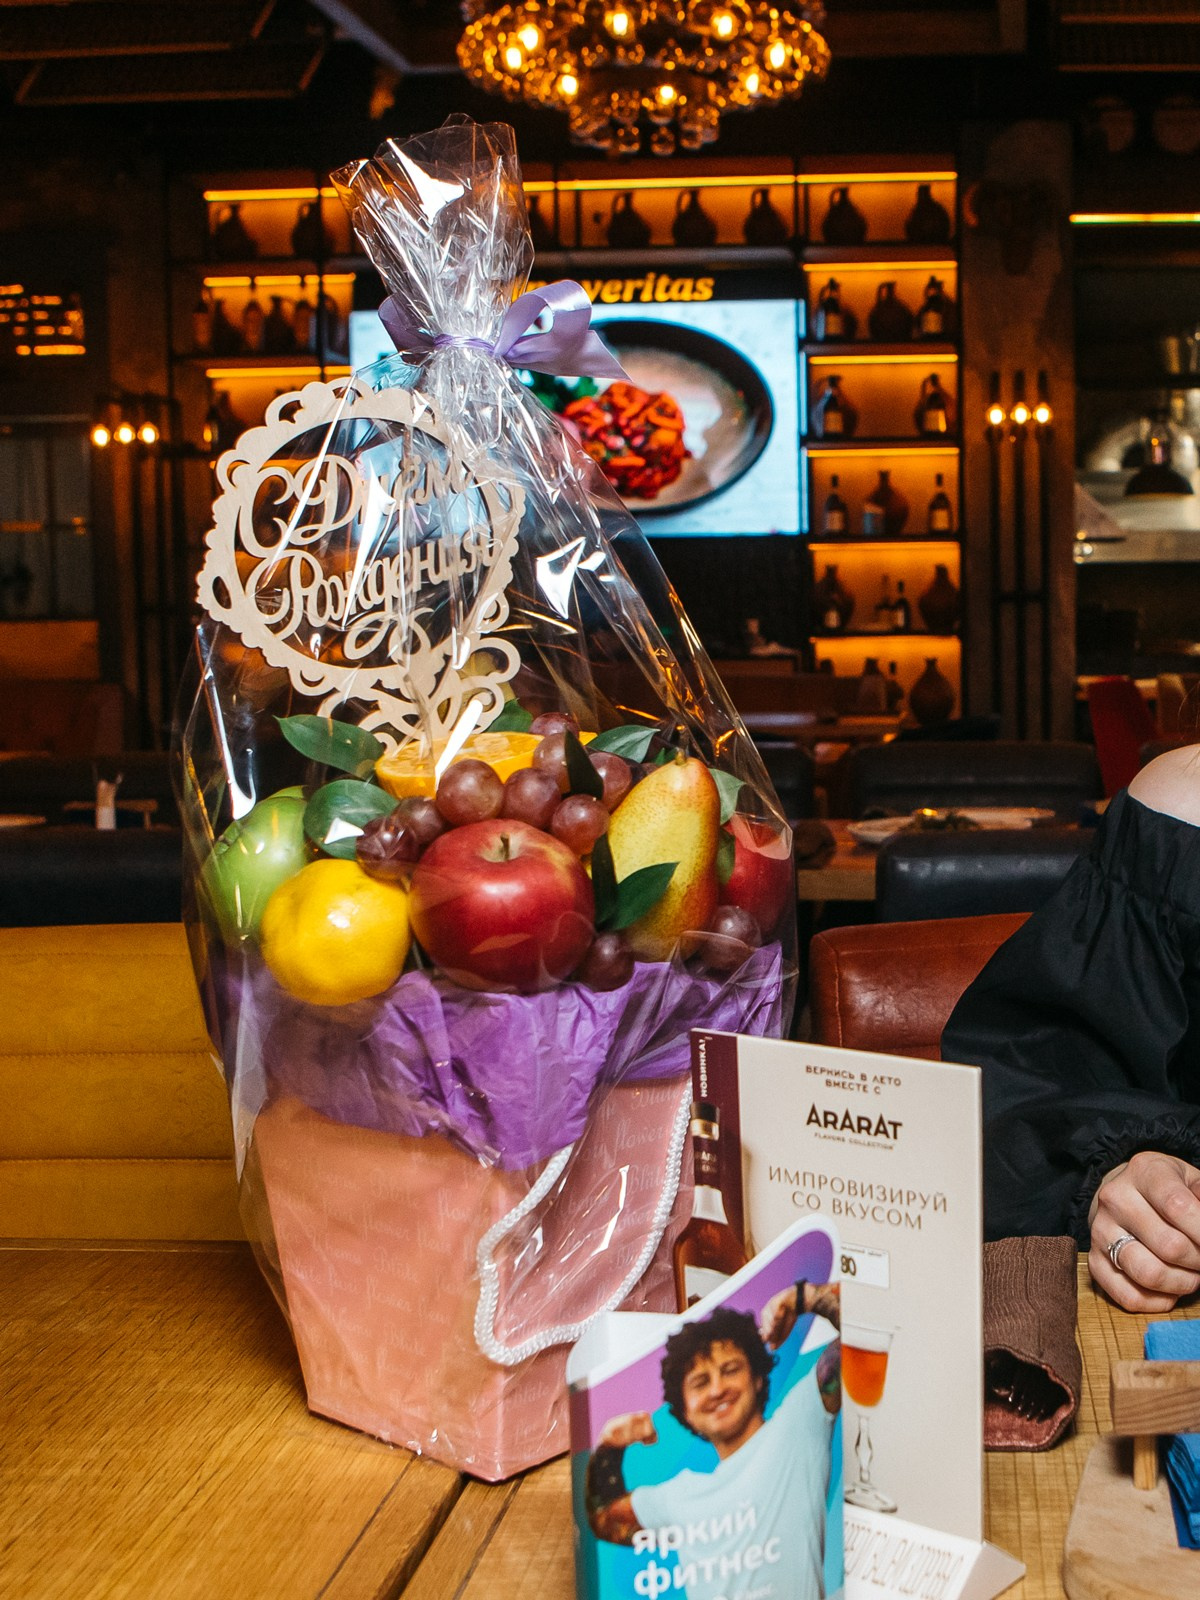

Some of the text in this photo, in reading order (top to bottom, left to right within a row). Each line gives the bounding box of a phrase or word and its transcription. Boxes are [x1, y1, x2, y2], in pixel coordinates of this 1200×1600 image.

[698, 1038, 708, 1098] НОВИНКА!
[805, 1064, 902, 1087] ВЕРНИСЬ В ЛЕТО
[825, 1078, 882, 1095] ВМЕСТЕ С
[806, 1101, 903, 1140] ARARAT
[769, 1165, 948, 1213] ИМПРОВИЗИРУЙ
[791, 1190, 922, 1230] СО ВКУСОМ
[631, 1500, 757, 1560] яркий
[633, 1536, 782, 1600] фитнес
